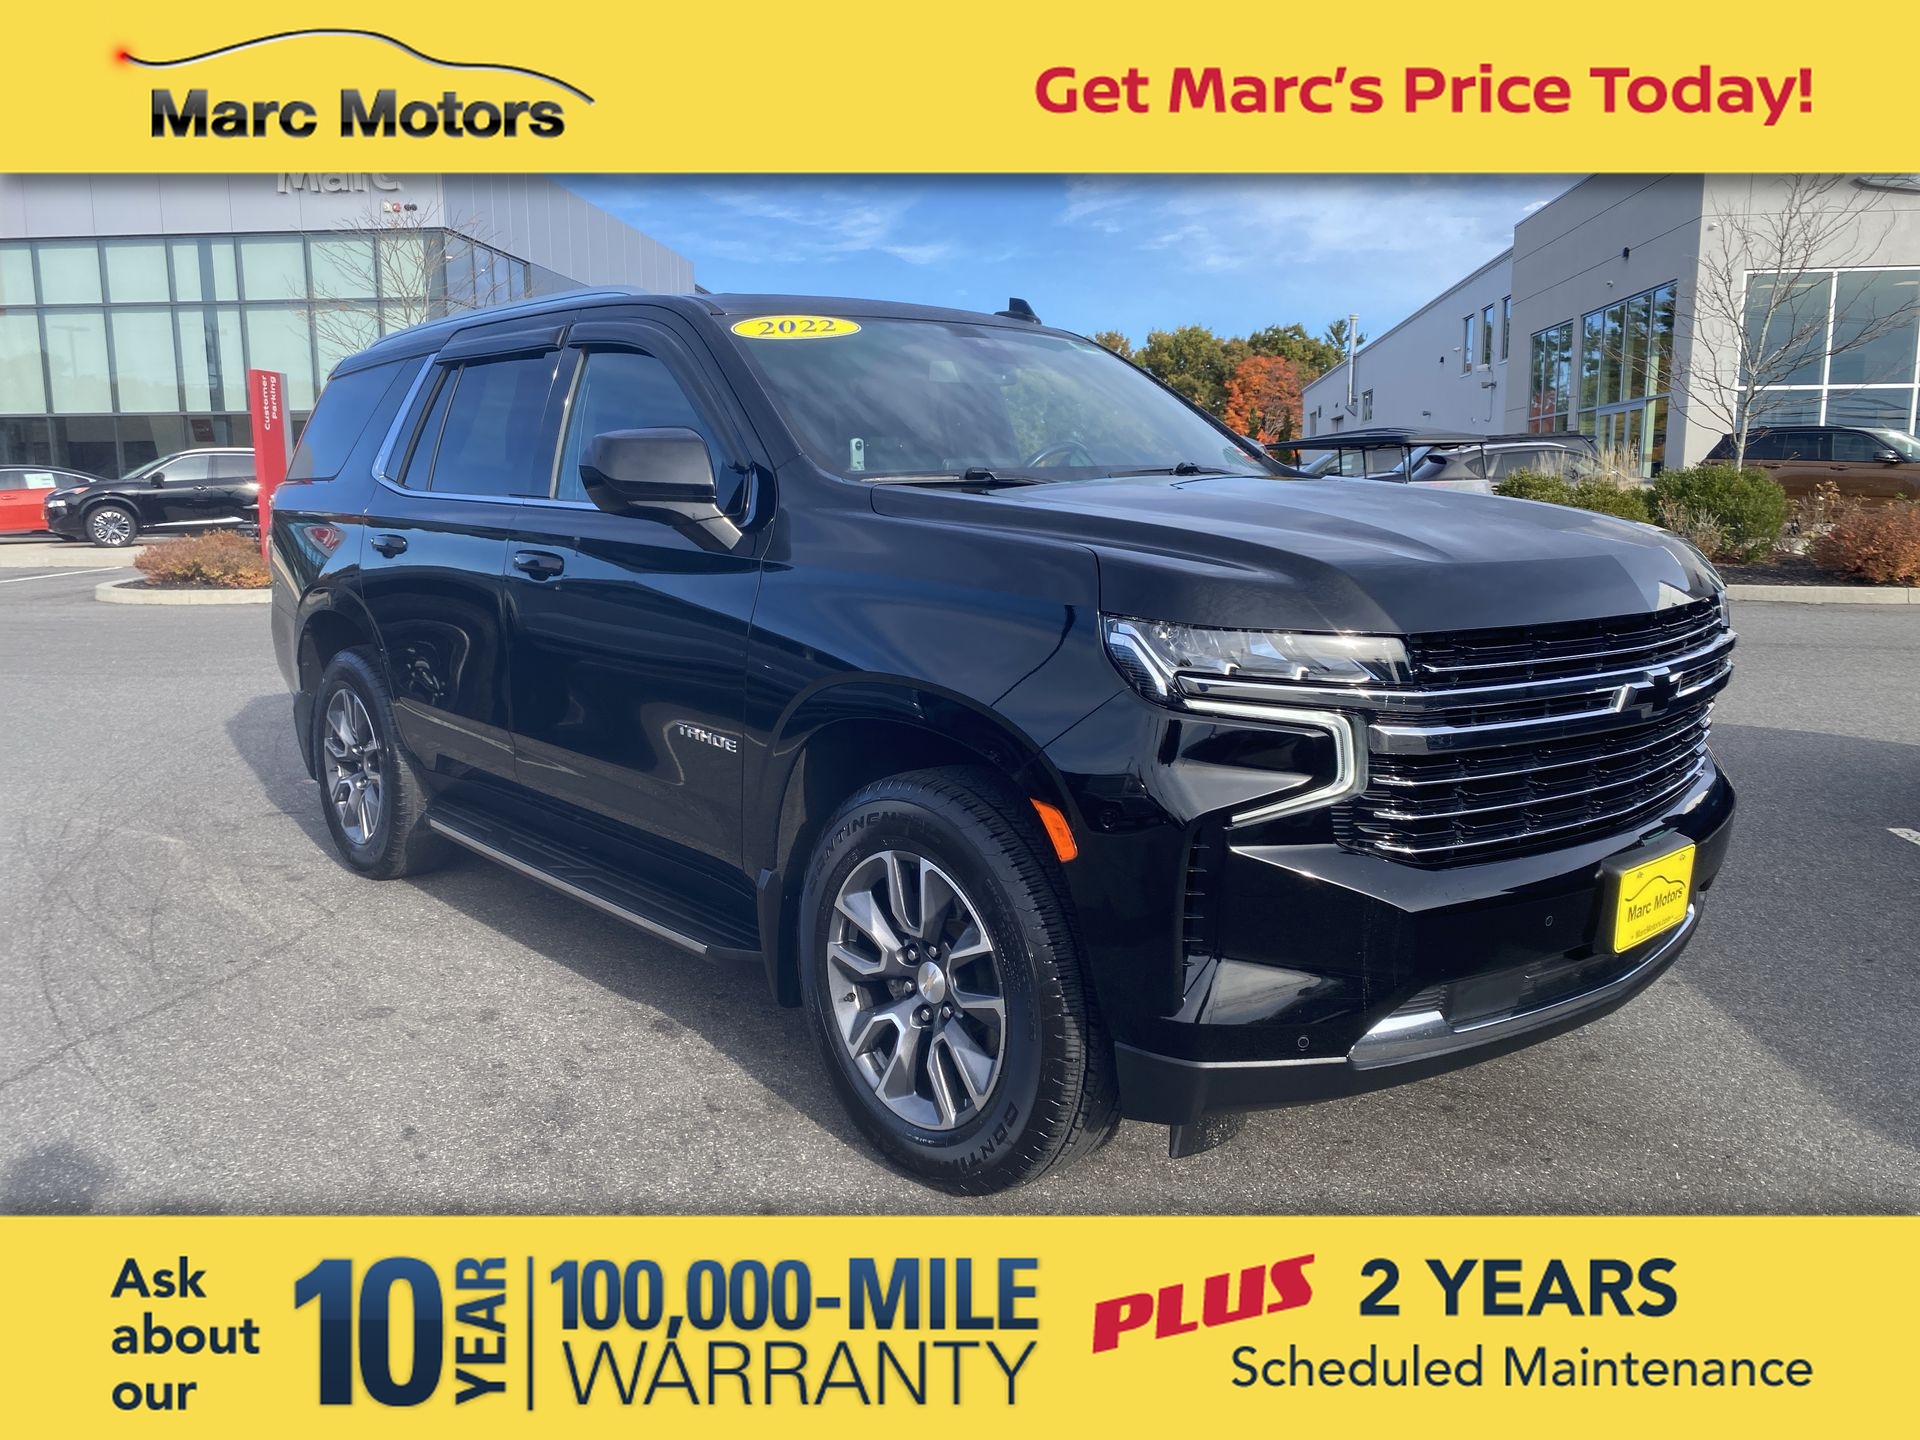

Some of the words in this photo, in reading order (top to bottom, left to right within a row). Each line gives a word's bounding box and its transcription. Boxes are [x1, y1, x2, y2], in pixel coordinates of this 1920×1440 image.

[758, 320, 837, 336] 2022
[262, 375, 271, 431] Customer
[270, 376, 278, 420] Parking
[676, 721, 737, 753] TAHOE
[1627, 901, 1652, 923] Marc
[1653, 887, 1683, 911] Motors
